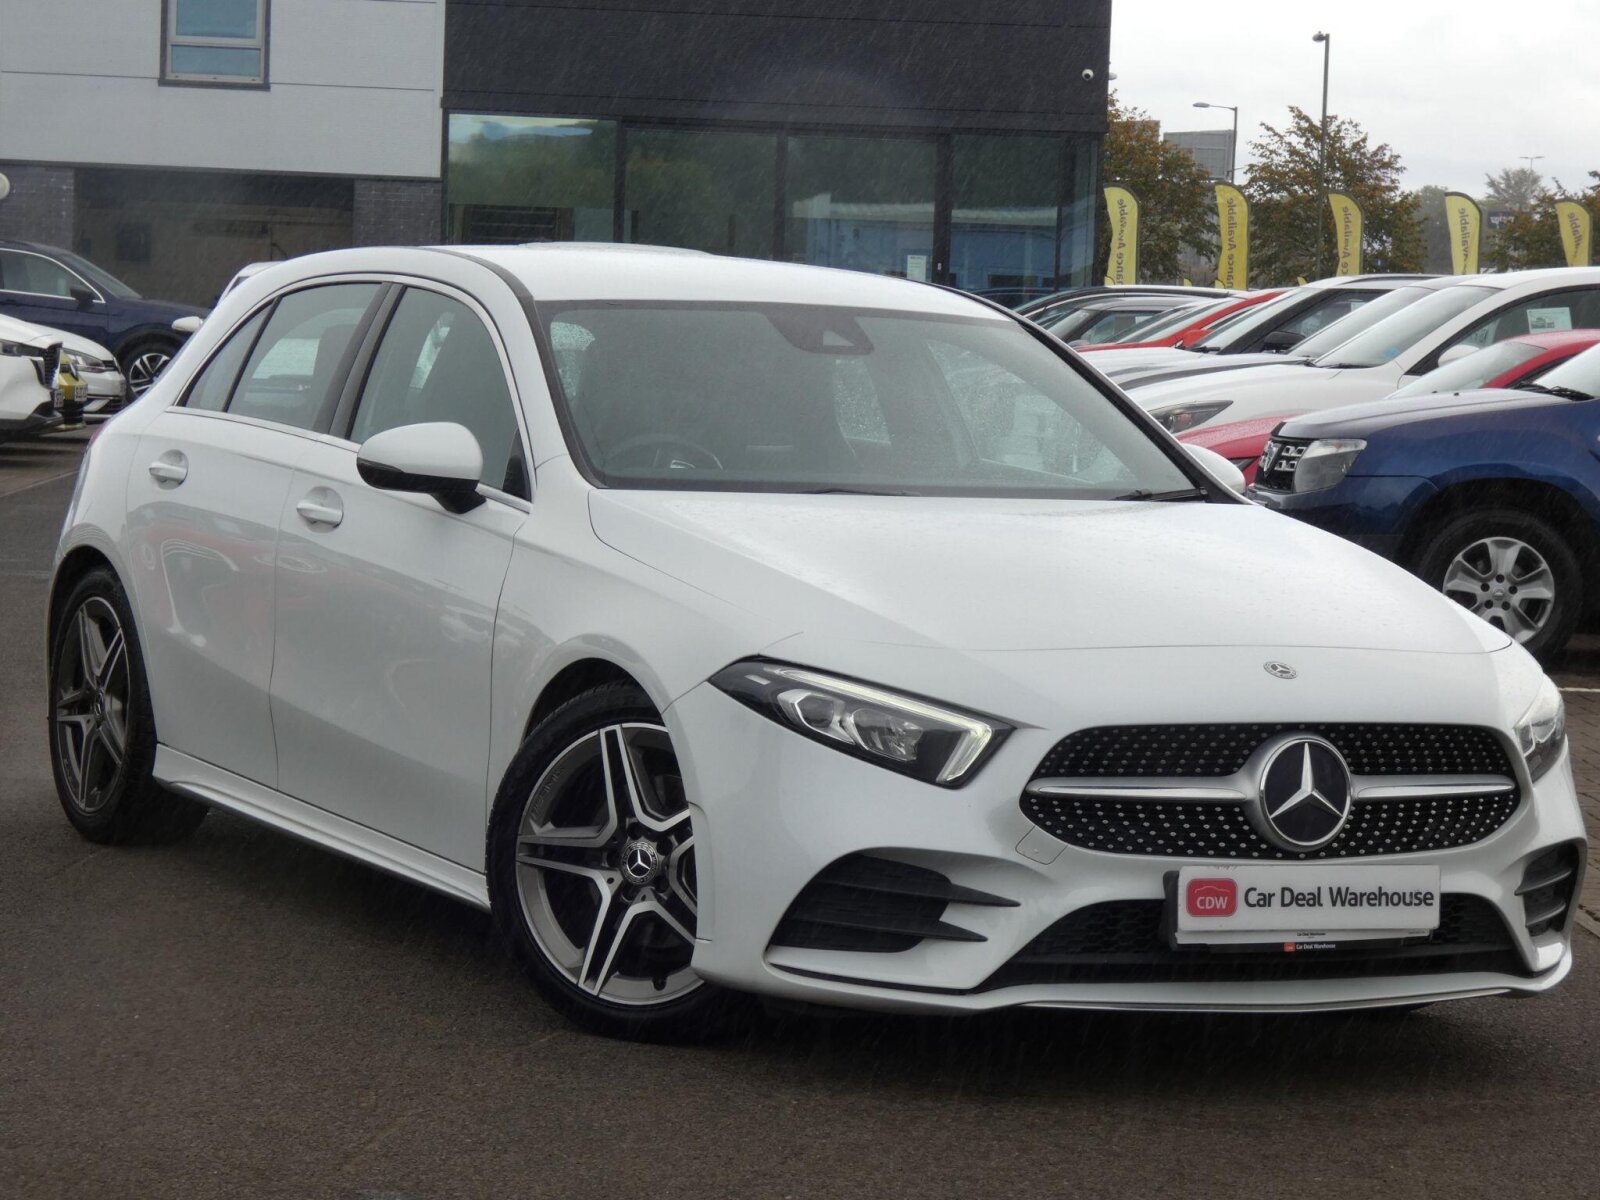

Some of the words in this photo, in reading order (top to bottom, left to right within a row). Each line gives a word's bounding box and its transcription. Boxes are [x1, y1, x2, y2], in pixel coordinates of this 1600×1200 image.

[1196, 896, 1228, 910] CDW
[1244, 887, 1275, 908] Car
[1280, 886, 1323, 908] Deal
[1328, 886, 1434, 907] Warehouse
